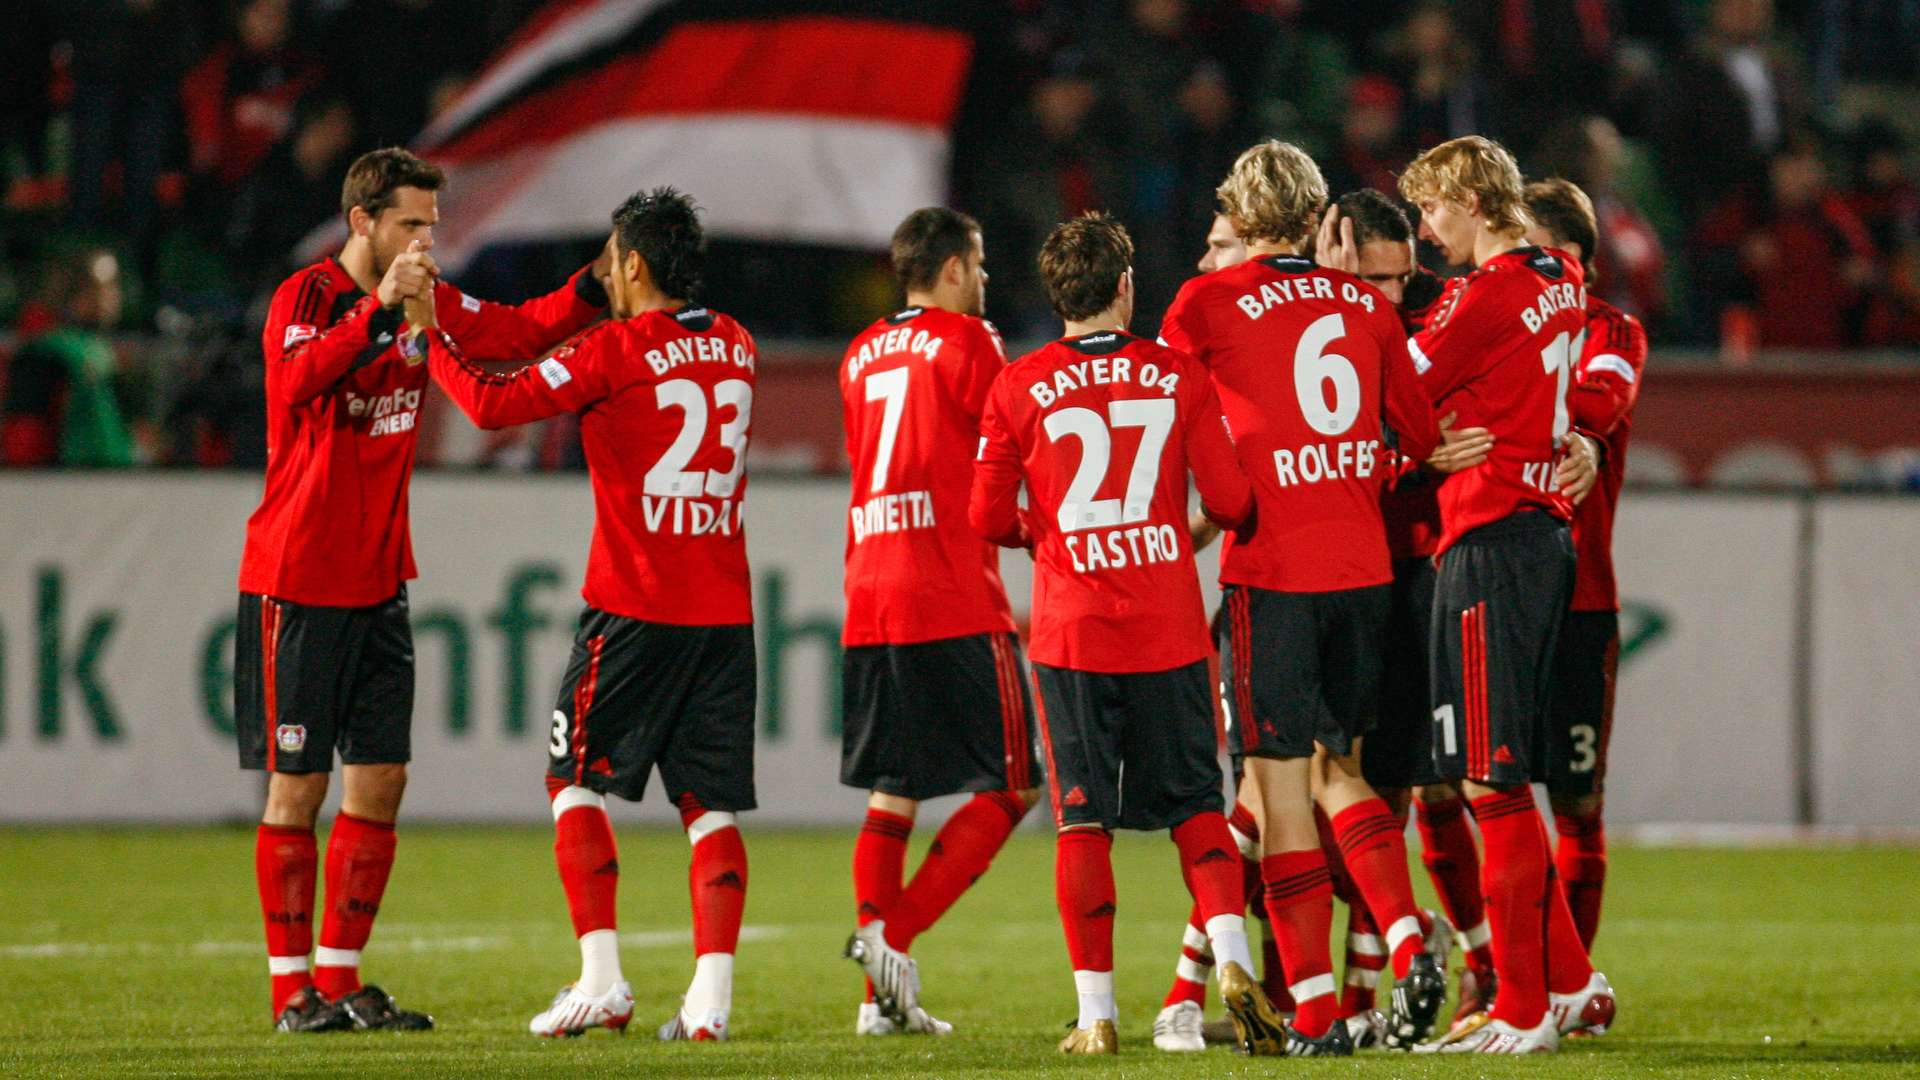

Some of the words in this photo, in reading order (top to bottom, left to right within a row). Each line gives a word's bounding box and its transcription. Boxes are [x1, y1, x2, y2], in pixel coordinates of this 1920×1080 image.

[1236, 277, 1335, 320] BAYER
[1342, 282, 1375, 313] 04
[1520, 283, 1576, 334] BAYER
[644, 336, 727, 376] BAYER
[847, 327, 912, 383] BAYER
[911, 329, 944, 362] 04
[1294, 313, 1360, 436] 6
[1029, 357, 1130, 408] BAYER
[1139, 363, 1180, 396] 04
[1540, 328, 1586, 449] 1
[369, 408, 417, 437] ENER
[643, 378, 753, 498] 23
[865, 366, 909, 494] 7
[1043, 398, 1176, 533] 27
[1273, 440, 1379, 487] ROLFES
[1065, 524, 1179, 573] CASTRO
[550, 710, 567, 758] 3
[1569, 724, 1597, 773] 3
